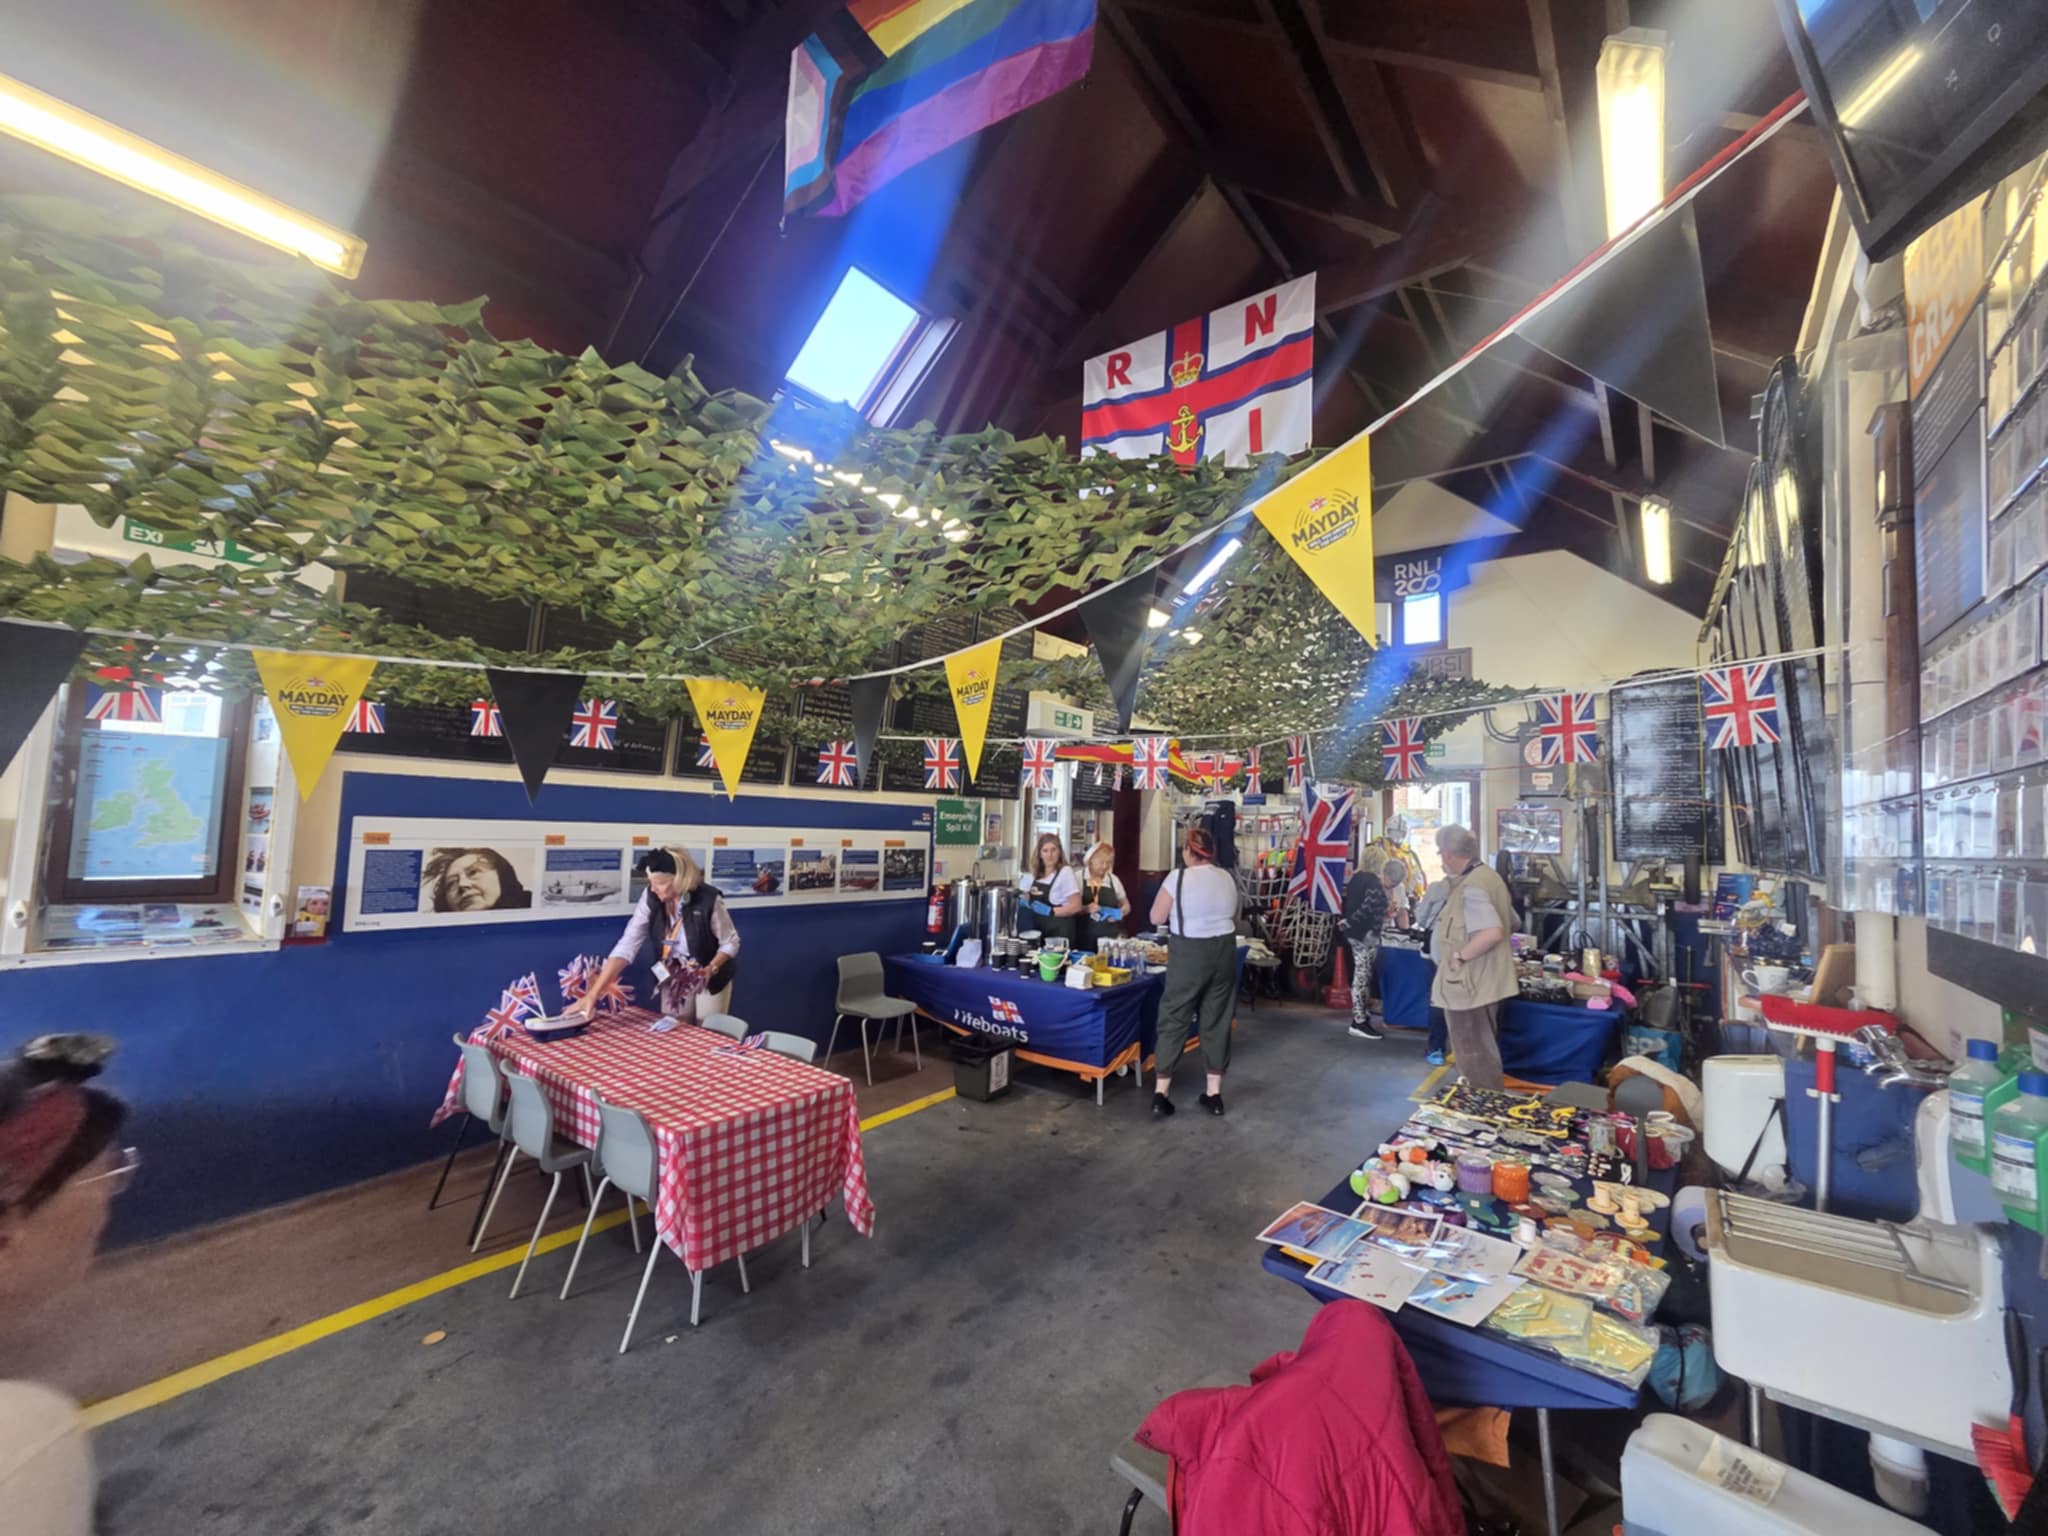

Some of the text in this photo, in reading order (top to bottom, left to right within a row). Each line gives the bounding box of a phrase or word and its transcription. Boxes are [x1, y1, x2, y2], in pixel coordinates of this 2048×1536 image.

[1106, 293, 1277, 390] R N
[1248, 407, 1263, 455] I
[1291, 496, 1359, 548] MAYDAY
[129, 526, 164, 544] EXI
[1394, 556, 1442, 580] RNLI
[1394, 573, 1441, 596] 200
[278, 689, 350, 706] MAYDAY
[957, 679, 990, 698] MAYDAY
[706, 710, 754, 721] MAYDAY
[945, 823, 961, 833] Spill
